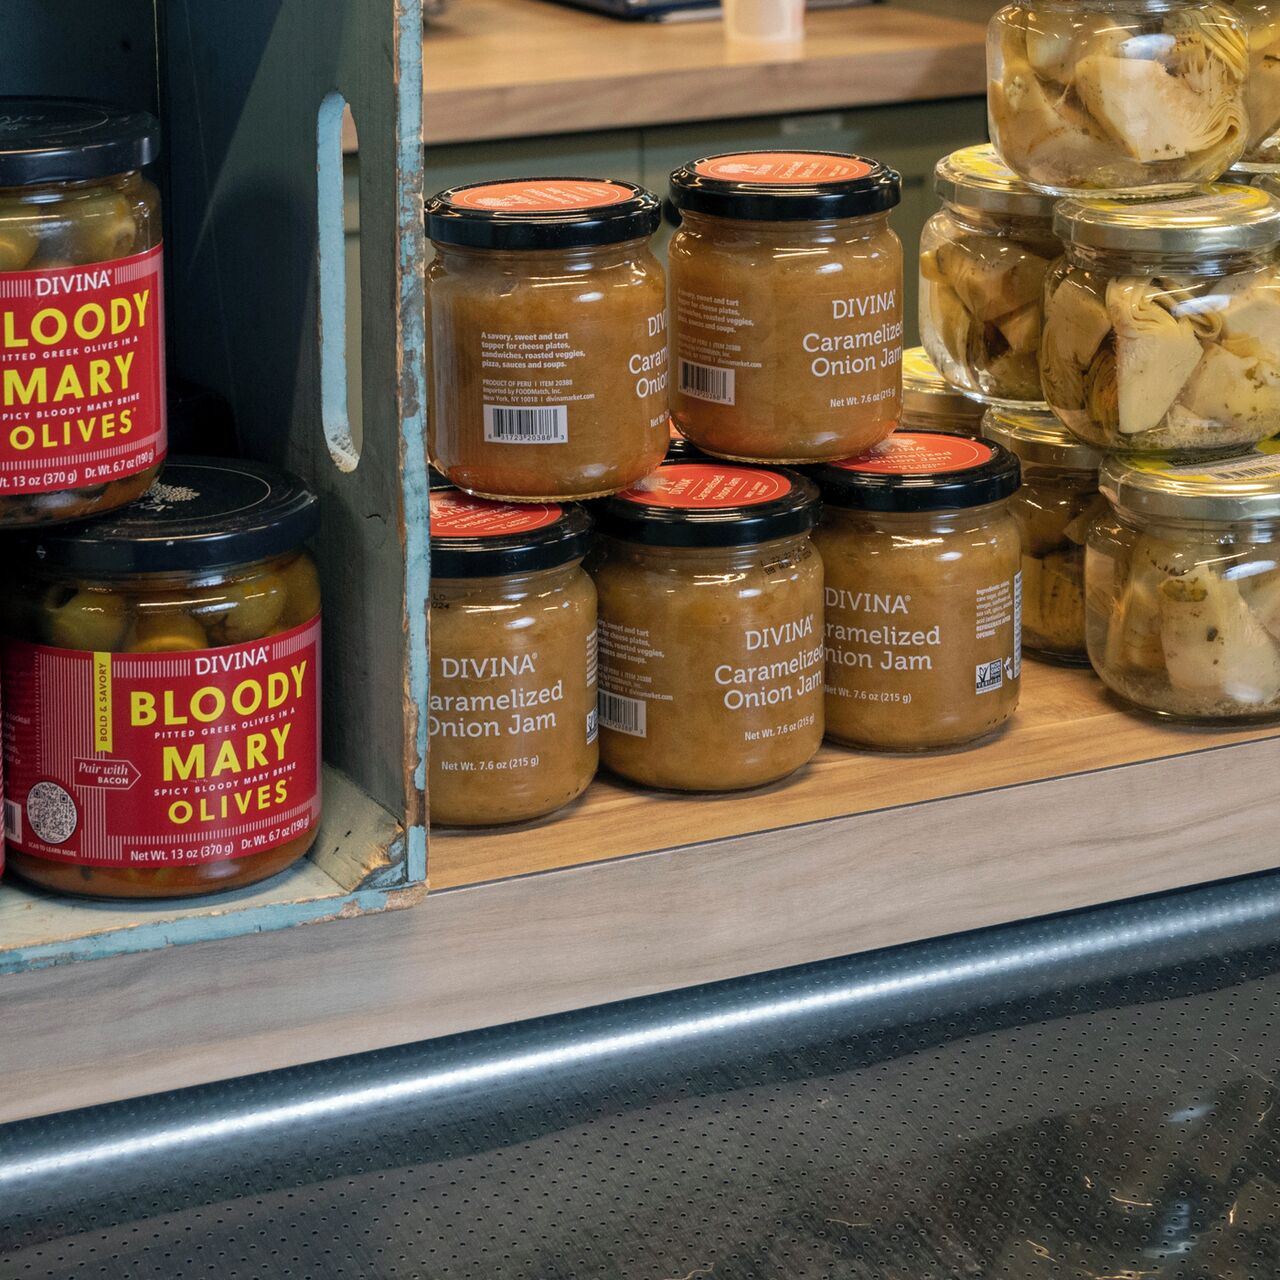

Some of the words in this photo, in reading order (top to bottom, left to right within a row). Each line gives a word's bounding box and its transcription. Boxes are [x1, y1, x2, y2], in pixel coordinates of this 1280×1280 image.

[35, 270, 111, 296] DIVINA
[832, 292, 895, 319] DIVINA
[811, 356, 876, 377] Onion
[881, 345, 902, 368] Jam
[3, 351, 135, 406] MARY
[9, 410, 132, 450] OLIVES
[824, 587, 908, 614] DIVINA
[745, 616, 812, 650] DIVINA
[194, 648, 269, 676] DIVINA
[441, 655, 535, 679] DIVINA
[714, 642, 824, 685] Caramelized
[99, 662, 107, 704] SAVORY
[130, 660, 308, 727] BLOODY
[429, 680, 563, 711] aramelized
[724, 686, 792, 710] Onion
[797, 671, 822, 696] Jam
[100, 705, 107, 713] &
[508, 712, 556, 735] Jam
[99, 714, 108, 742] BOLD
[154, 729, 195, 740] PITTED
[201, 724, 237, 736] GREEK
[241, 714, 275, 730] OLIVES
[278, 710, 288, 719] IN
[163, 723, 292, 782] MARY
[78, 762, 99, 774] Pair
[102, 764, 129, 775] with
[97, 776, 129, 785] BACON
[154, 788, 188, 797] SPICY
[194, 780, 239, 794] BLOODY
[243, 772, 269, 785] MARY
[272, 762, 297, 777] BRINE
[168, 780, 288, 825] OLIVES
